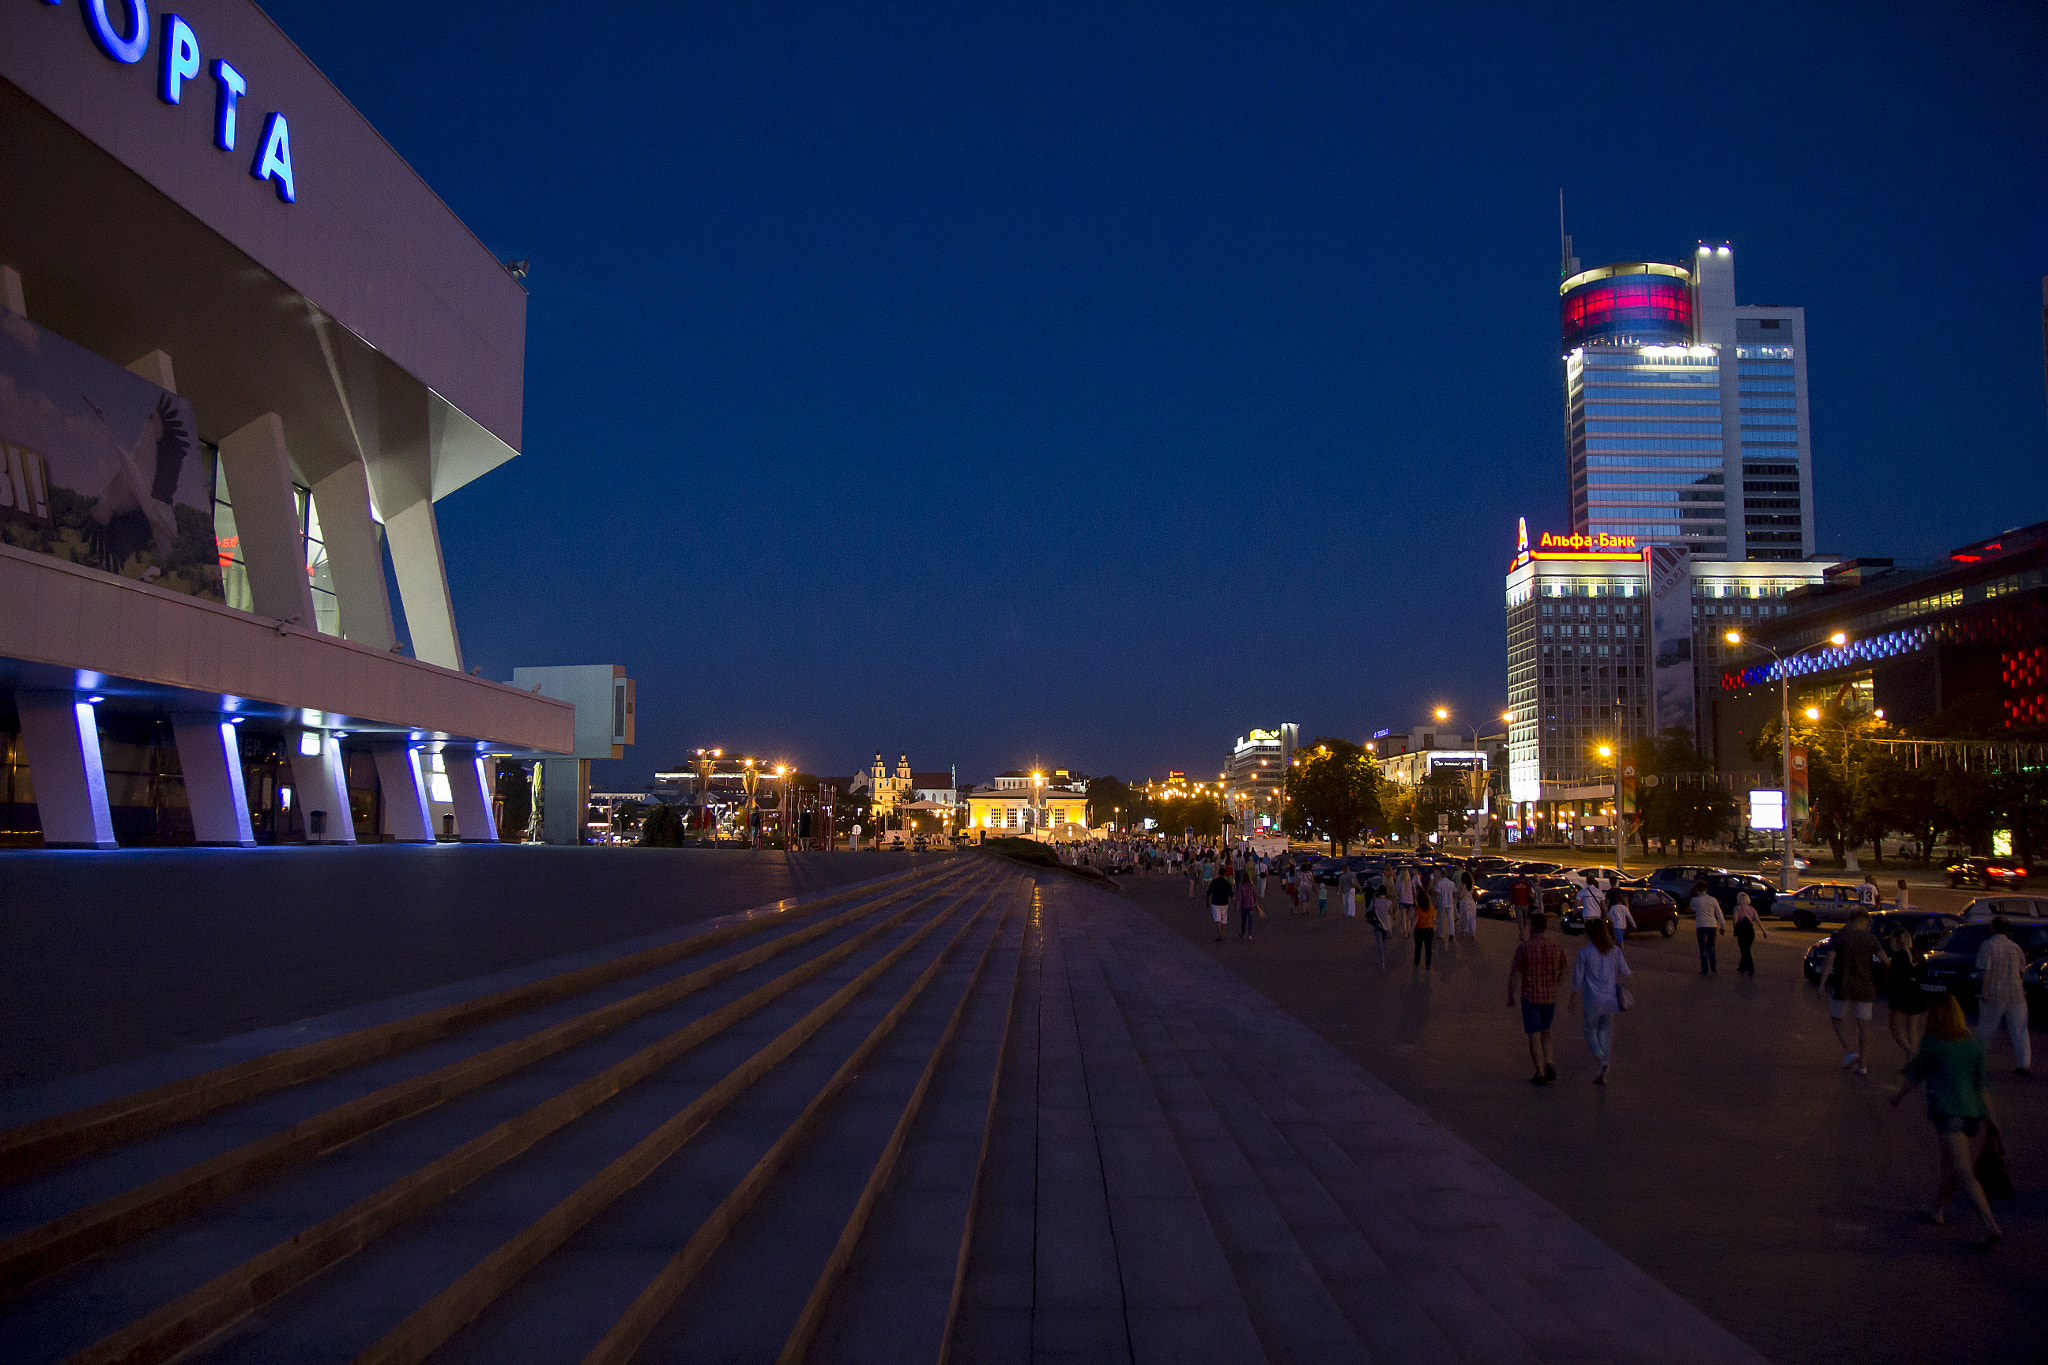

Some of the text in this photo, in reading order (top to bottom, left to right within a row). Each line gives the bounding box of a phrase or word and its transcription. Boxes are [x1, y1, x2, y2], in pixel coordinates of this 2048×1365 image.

[38, 0, 297, 204] ОРТА
[1540, 531, 1636, 550] Альфа-Банк
[1654, 566, 1686, 599] СПОРТ
